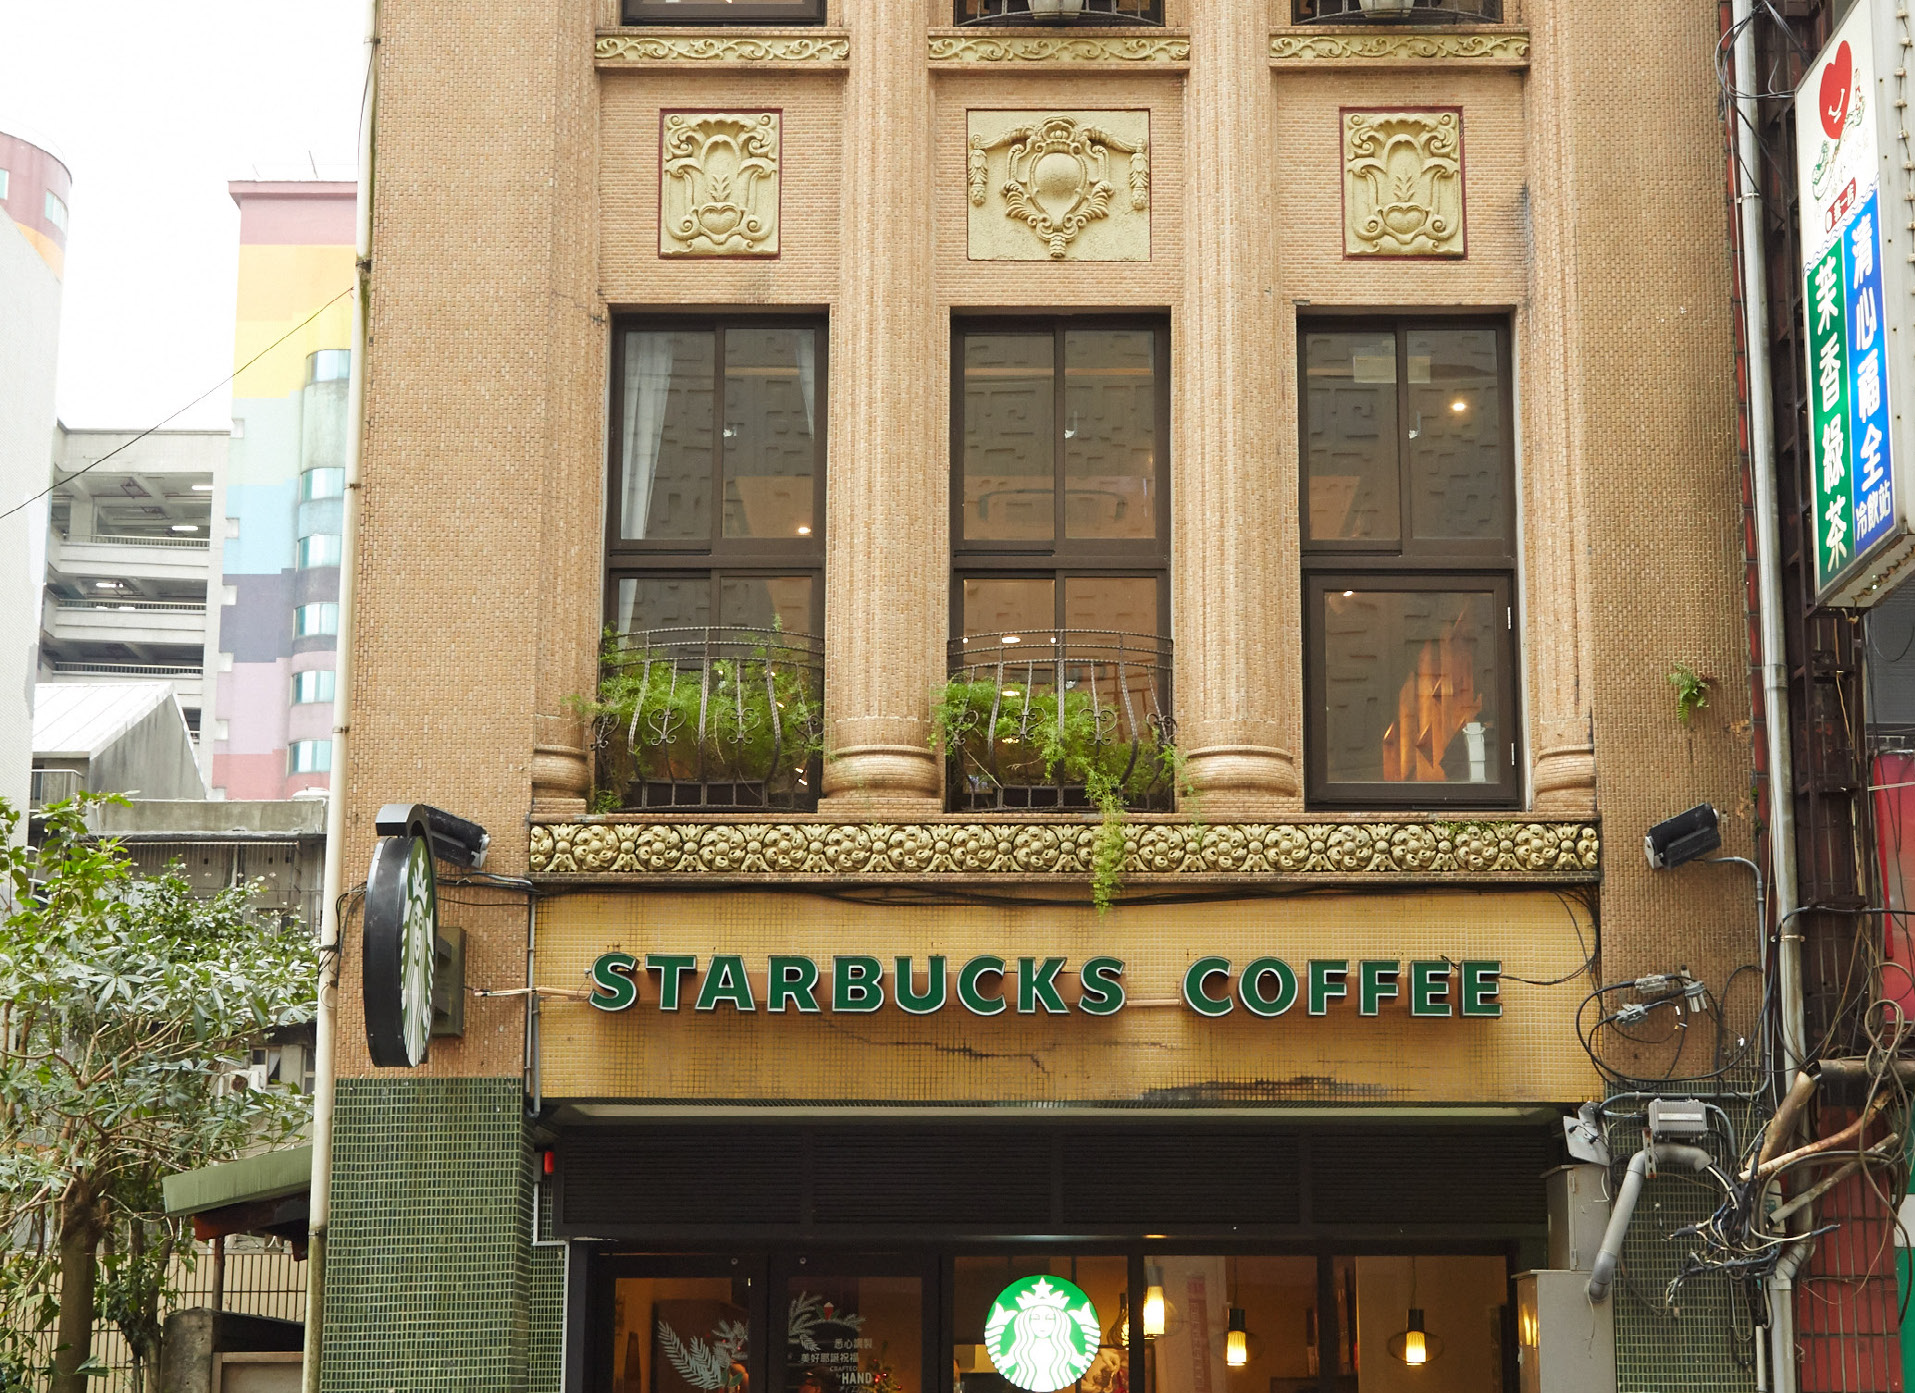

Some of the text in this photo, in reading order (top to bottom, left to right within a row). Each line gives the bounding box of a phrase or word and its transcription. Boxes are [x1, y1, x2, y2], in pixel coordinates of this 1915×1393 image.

[1851, 212, 1883, 492] 清心福全
[1815, 255, 1847, 572] 茉香綠茶
[1855, 479, 1891, 541] 冷飲站
[588, 951, 1503, 1018] STARBUCKS COFFEE
[841, 1372, 873, 1385] HAND
